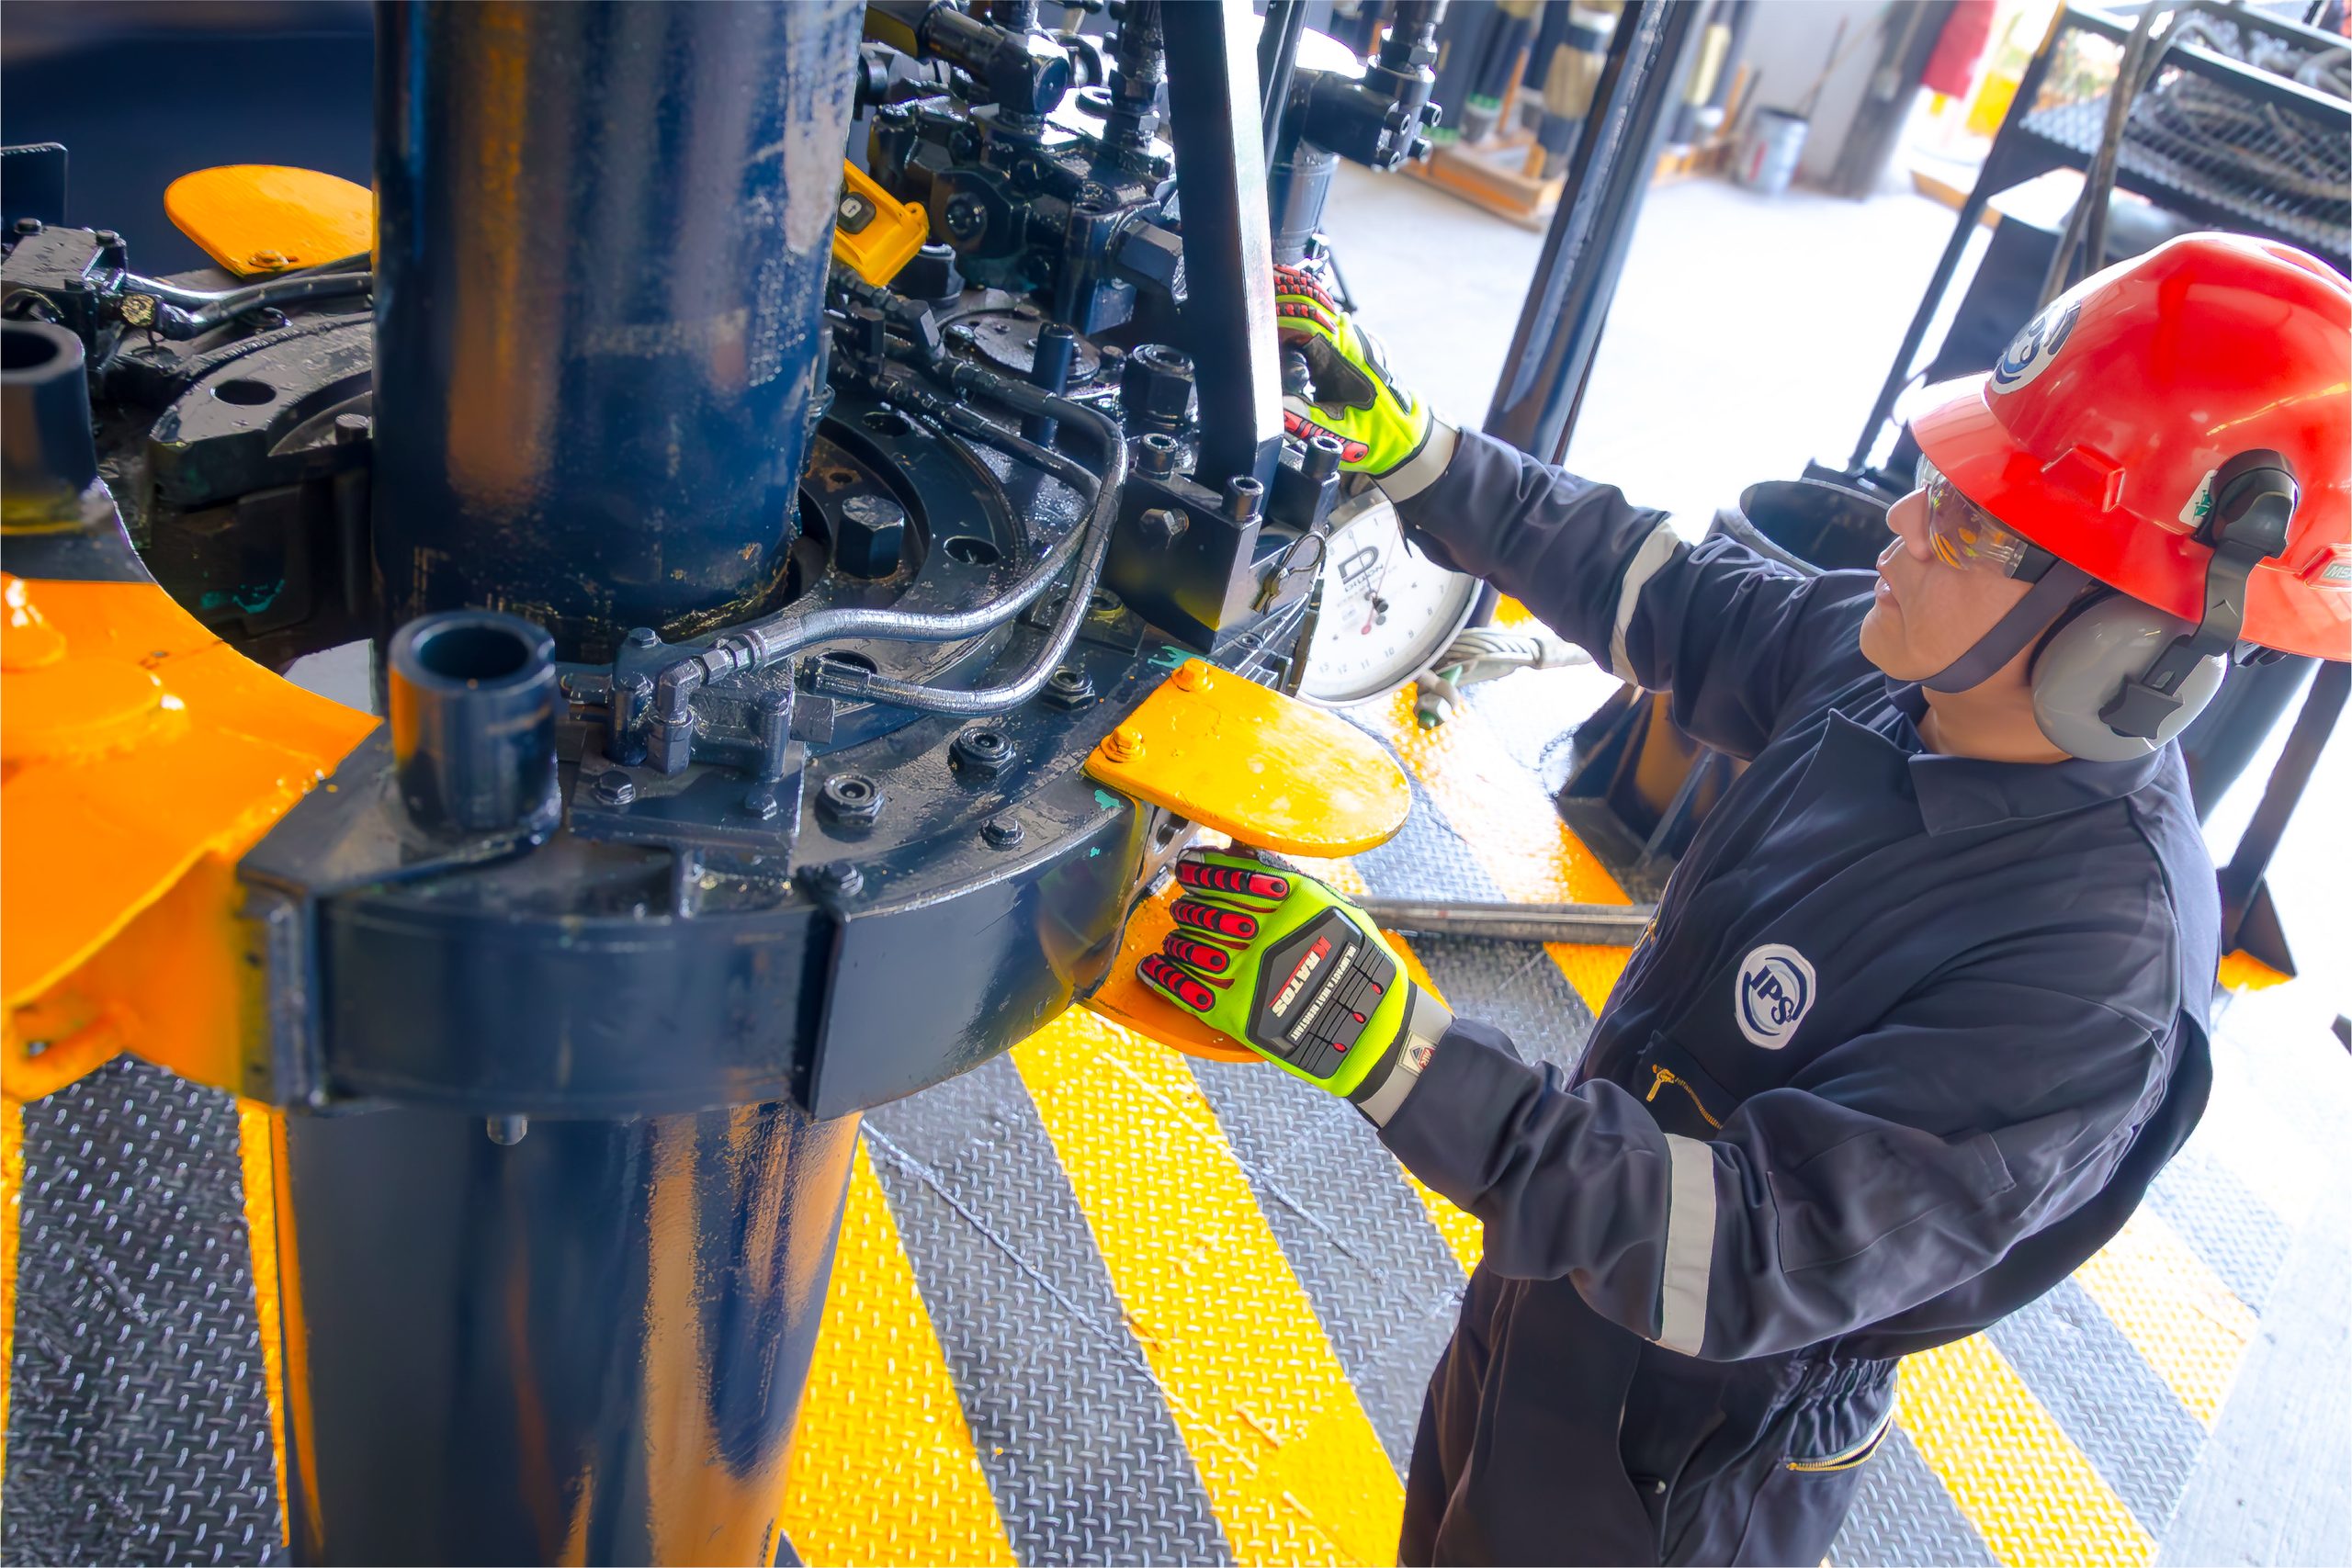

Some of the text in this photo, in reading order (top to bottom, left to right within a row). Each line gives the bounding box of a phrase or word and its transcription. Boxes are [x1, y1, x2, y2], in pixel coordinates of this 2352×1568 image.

[1344, 563, 1383, 592] DILLON
[2325, 564, 2351, 579] MS
[1385, 647, 1395, 658] 10
[1338, 663, 1347, 675] 12
[1361, 659, 1370, 670] 11
[1269, 935, 1332, 1018] KRATOS
[1316, 987, 1332, 1007] HEAT
[1750, 965, 1794, 1025] IPS
[1290, 1003, 1320, 1042] RESISTANT
